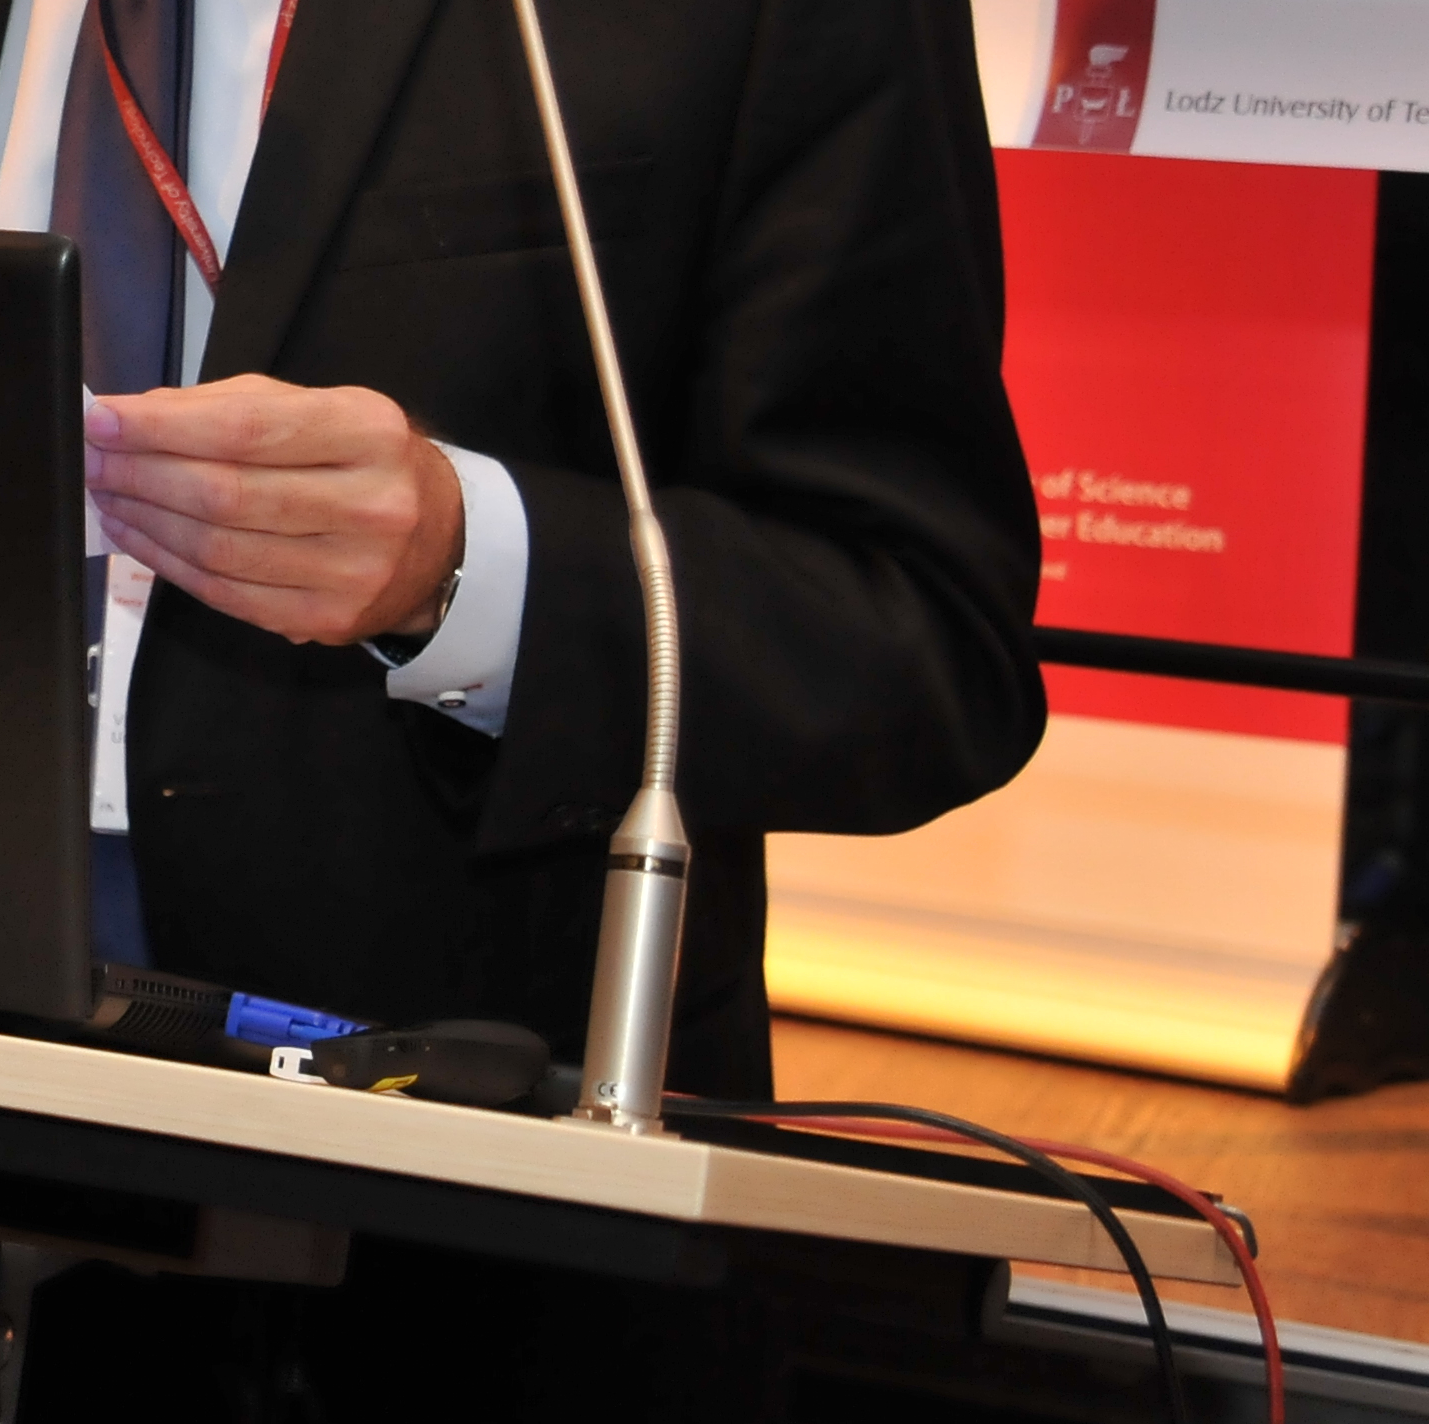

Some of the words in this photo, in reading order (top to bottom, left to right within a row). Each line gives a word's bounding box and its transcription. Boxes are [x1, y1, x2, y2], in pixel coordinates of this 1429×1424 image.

[1164, 89, 1226, 115] Lodz
[1233, 92, 1360, 124] University
[1367, 98, 1397, 123] of
